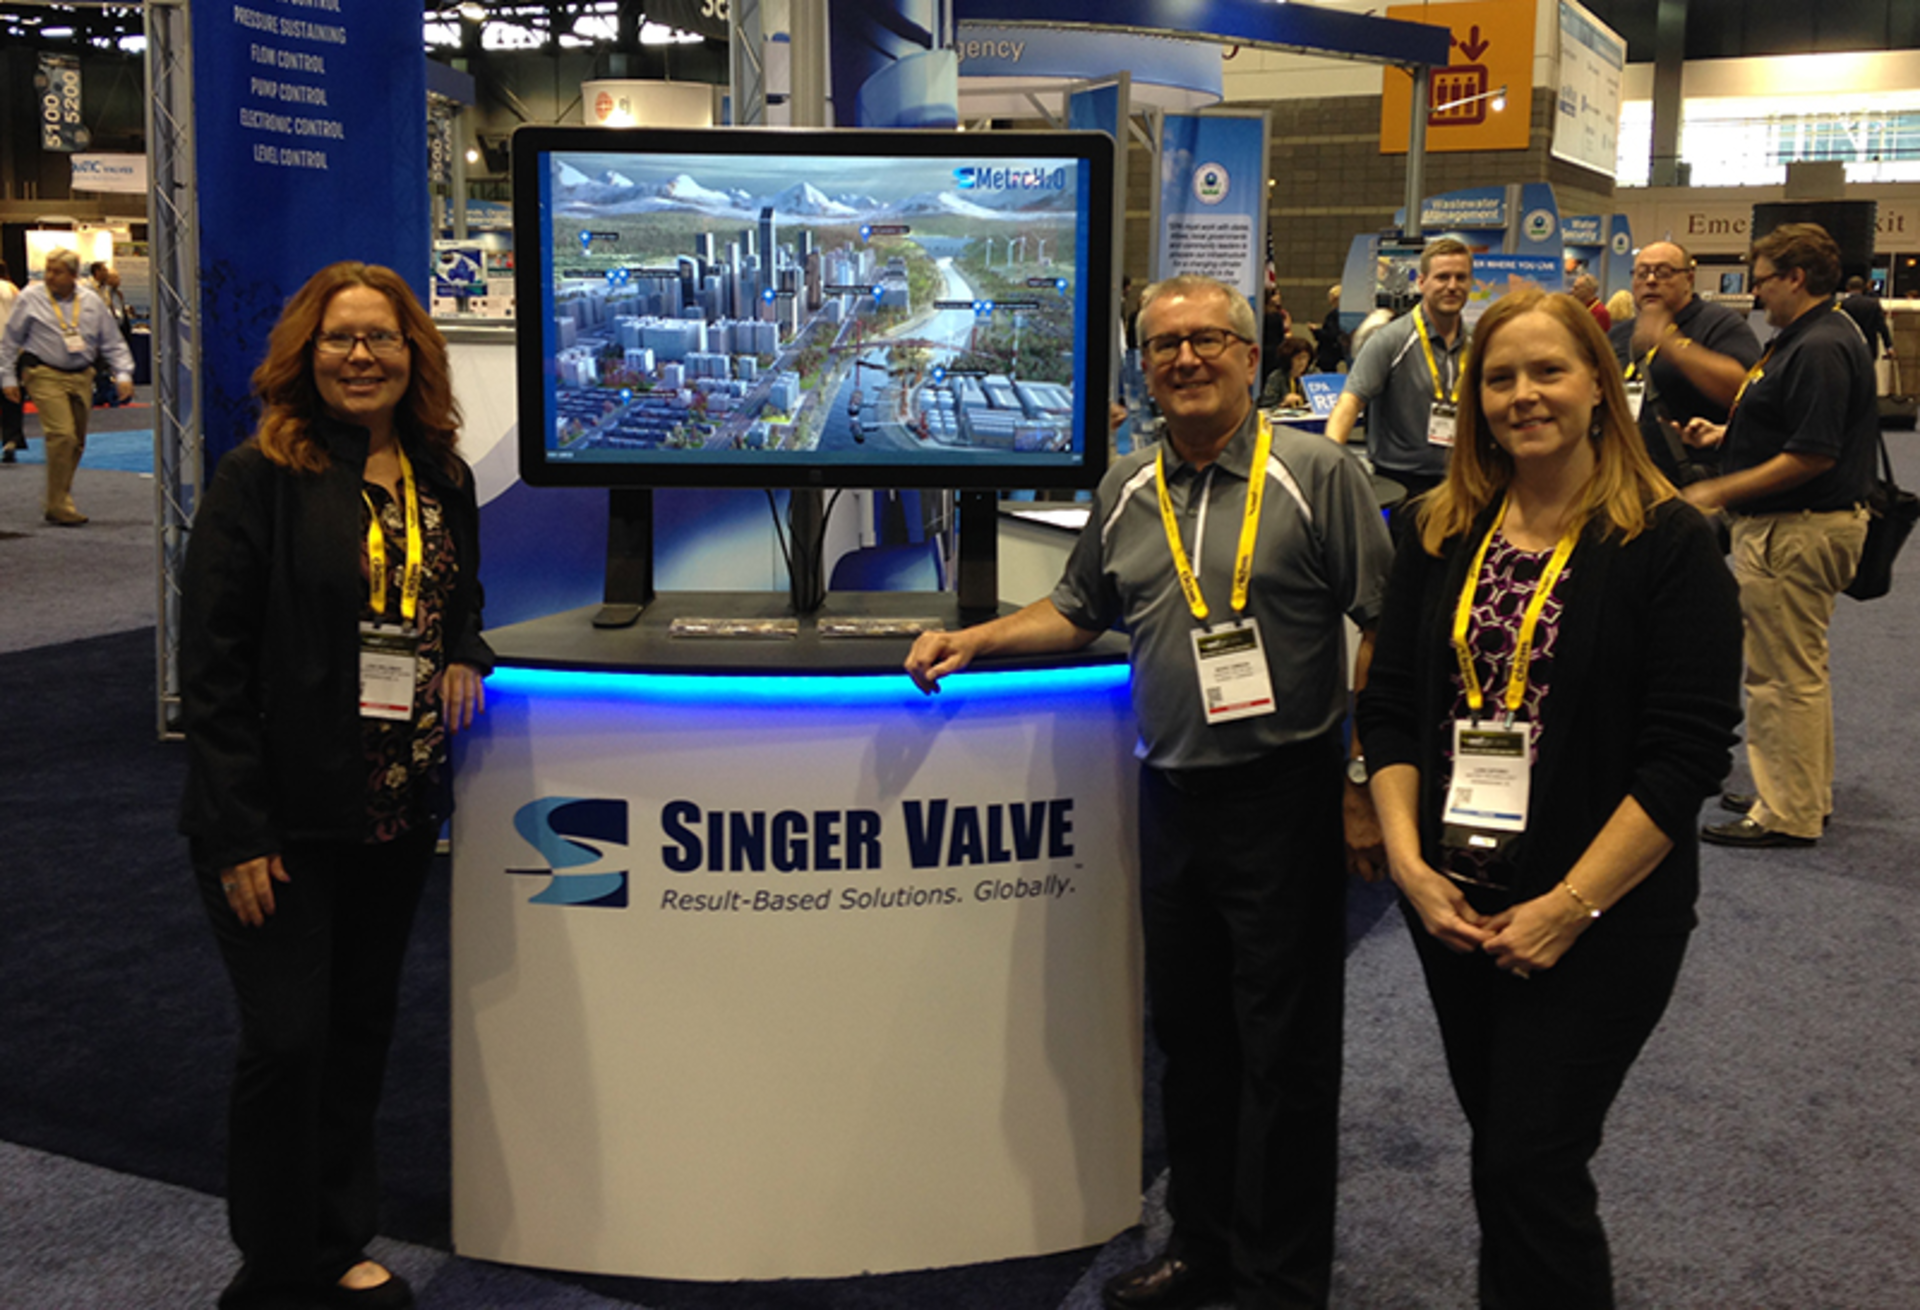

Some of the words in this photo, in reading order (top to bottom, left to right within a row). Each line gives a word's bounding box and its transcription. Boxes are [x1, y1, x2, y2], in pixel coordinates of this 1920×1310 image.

[234, 5, 279, 34] PRESSURE
[280, 17, 346, 44] SUSTAINING
[251, 43, 276, 65] FLOW
[278, 49, 326, 74] CONTROL
[957, 41, 1025, 62] gency
[62, 71, 80, 123] 5200
[251, 76, 277, 98] PUMP
[280, 83, 327, 106] CONTROL
[44, 94, 61, 147] 5100
[240, 107, 293, 134] ELECTRONIC
[294, 117, 344, 139] CONTROL
[254, 143, 279, 165] LEVEL
[280, 148, 328, 170] CONTROL
[1424, 209, 1498, 223] Management
[1433, 198, 1499, 210] Wastewater
[1487, 261, 1516, 269] WHERE
[661, 800, 882, 873] SINGER
[902, 798, 1074, 868] VALVE
[661, 887, 830, 911] Result-Based
[840, 884, 963, 909] Solutions.
[974, 874, 1076, 901] Globally.
